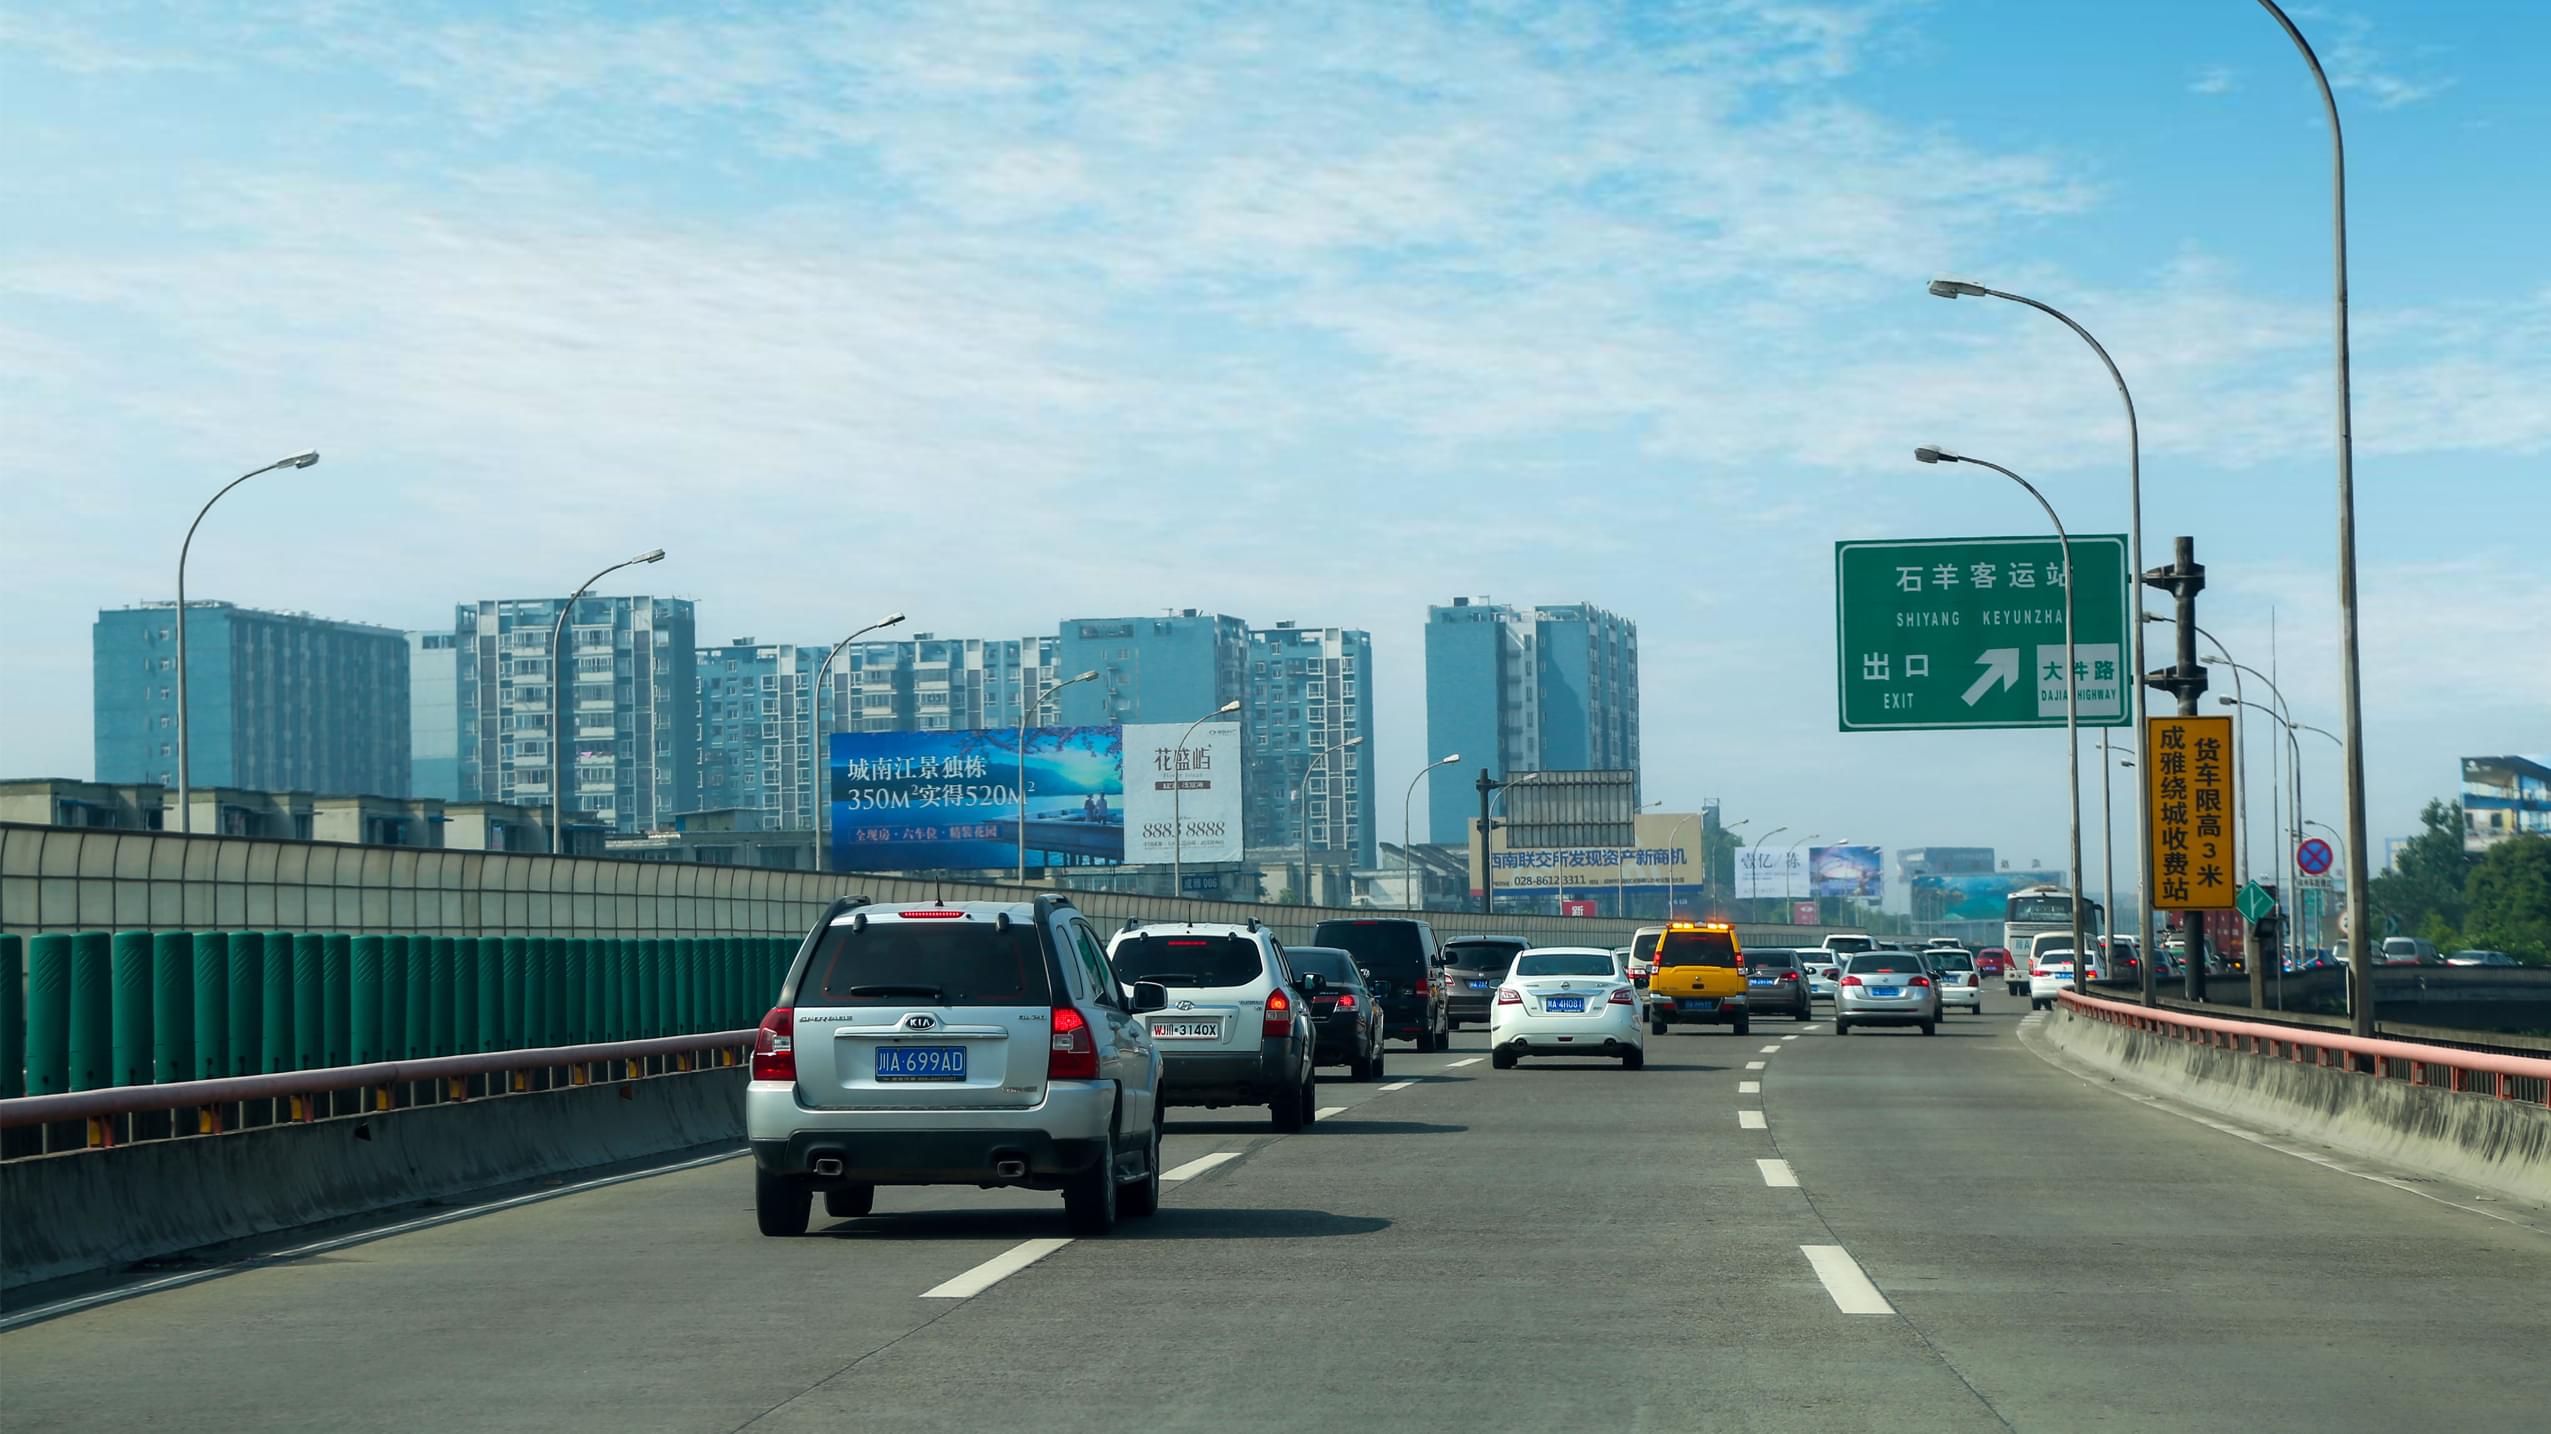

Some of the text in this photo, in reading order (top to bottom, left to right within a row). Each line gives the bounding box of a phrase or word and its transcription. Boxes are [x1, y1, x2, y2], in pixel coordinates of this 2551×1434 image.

[1896, 561, 2073, 592] 石羊客运站
[1896, 609, 2063, 627] SHIYANG KEYUNZHA
[1863, 652, 1929, 680] 出口
[1883, 692, 1914, 709] EXIT
[2041, 688, 2116, 701] DAJIA HIGHWAY
[848, 755, 987, 782] 城南江景独栋
[2160, 725, 2188, 902] 成雅绕城收费站
[2194, 737, 2223, 887] 货车限高3米
[1186, 821, 1225, 838] 8888
[1514, 875, 1587, 886] 028-86123311
[910, 1018, 930, 1026] KIA
